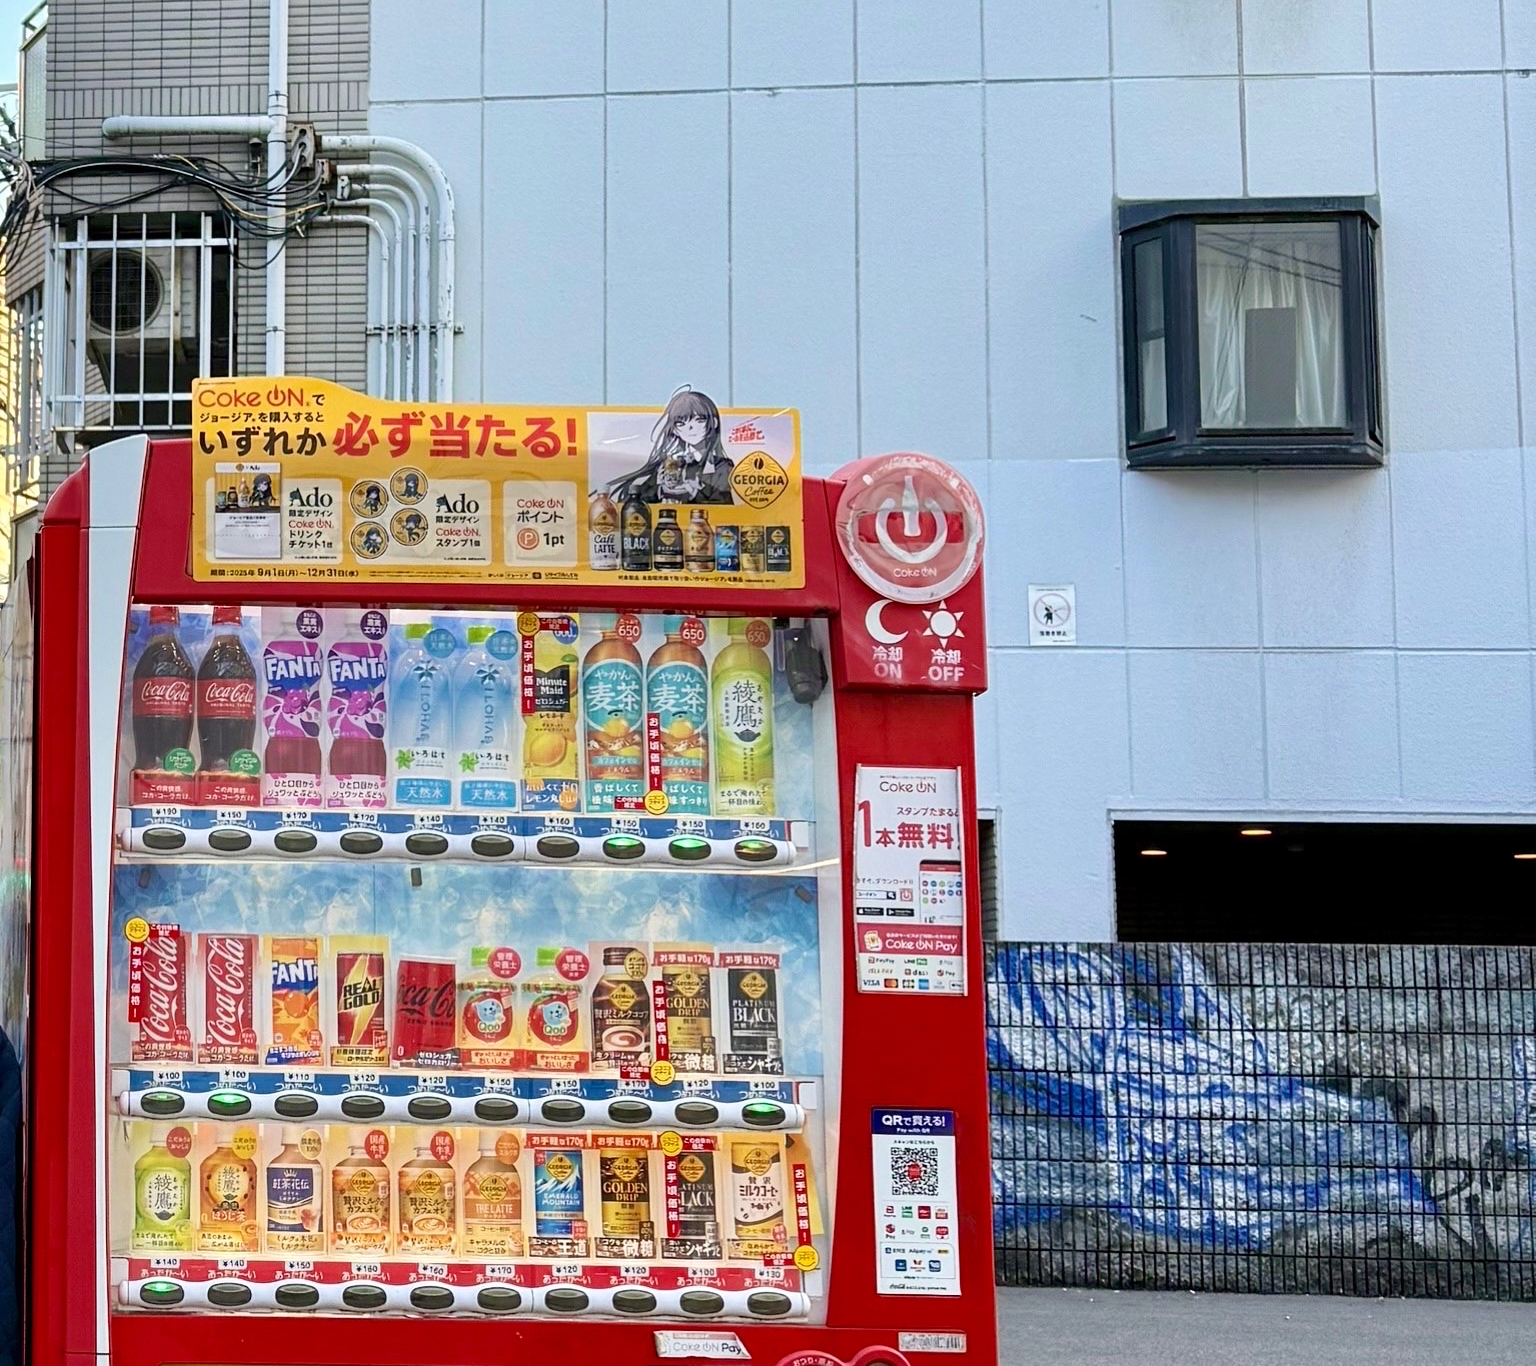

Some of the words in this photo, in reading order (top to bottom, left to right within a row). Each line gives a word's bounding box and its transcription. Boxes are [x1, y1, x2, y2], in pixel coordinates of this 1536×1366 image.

[198, 389, 261, 408] Coke
[199, 426, 327, 456] いずれか
[332, 411, 578, 459] 必ず当たる!
[734, 475, 784, 485] GEORGIA
[517, 499, 544, 509] Coke
[517, 511, 565, 523] ポイント
[289, 530, 323, 539] ドリンク
[543, 533, 565, 550] 1pt
[624, 537, 649, 549] BLACK
[893, 568, 920, 578] Coke
[618, 626, 640, 637] 650
[683, 629, 705, 640] 650
[872, 645, 903, 661] 冷却
[931, 648, 962, 664] 冷却
[266, 656, 321, 680] FANTA
[330, 658, 385, 682] FANTA
[874, 663, 902, 678] ON
[928, 666, 964, 682] OFF
[536, 678, 567, 686] Minute
[142, 681, 190, 701] Coca-Cola
[206, 683, 253, 703] Coca-Cola
[540, 686, 563, 695] Maid
[587, 681, 641, 712] 麦茶
[651, 683, 705, 713] 麦茶
[732, 680, 757, 728] 綾鷹
[407, 787, 443, 798] 天然水
[471, 788, 508, 800] 天然水
[880, 781, 913, 793] Coke
[885, 938, 915, 950] Coke
[935, 939, 958, 954] Pay
[141, 936, 178, 1042] Coca-Cola
[207, 937, 245, 1045] Coca-Cola
[343, 977, 381, 998] REAL
[343, 991, 380, 1010] GOLD
[666, 997, 710, 1009] GOLDEN
[733, 1008, 777, 1023] BLACK
[478, 1021, 500, 1033] Qoo
[544, 1023, 566, 1036] Qoo
[154, 1174, 172, 1210] 綾鷹
[603, 1182, 648, 1194] GOLDEN
[615, 1193, 639, 1201] DRIP
[475, 1203, 489, 1213] THE
[490, 1203, 513, 1214] LATTE
[558, 1240, 587, 1256] 王道
[556, 1265, 578, 1274] ¥120
[721, 1342, 743, 1355] Pay
